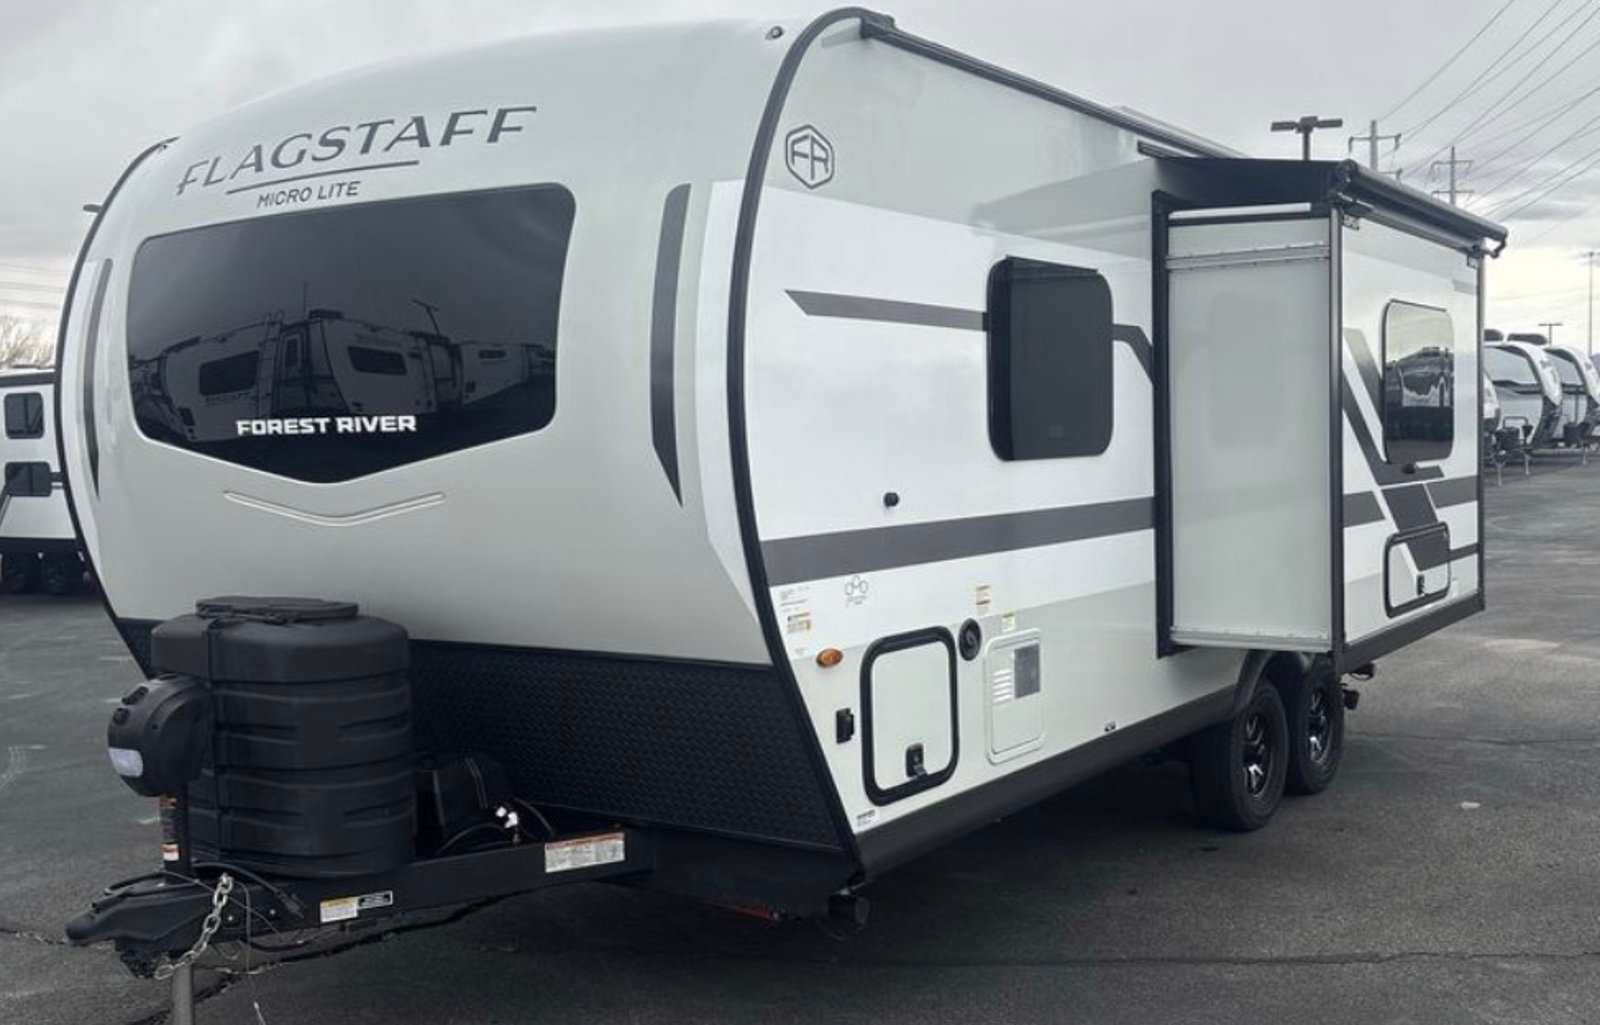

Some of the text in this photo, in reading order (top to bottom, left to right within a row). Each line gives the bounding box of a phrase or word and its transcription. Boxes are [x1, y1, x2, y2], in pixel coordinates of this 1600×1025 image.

[176, 106, 537, 196] FLAGSTAFF
[256, 180, 361, 208] MICRO LITE
[235, 415, 417, 436] FOREST RIVER
